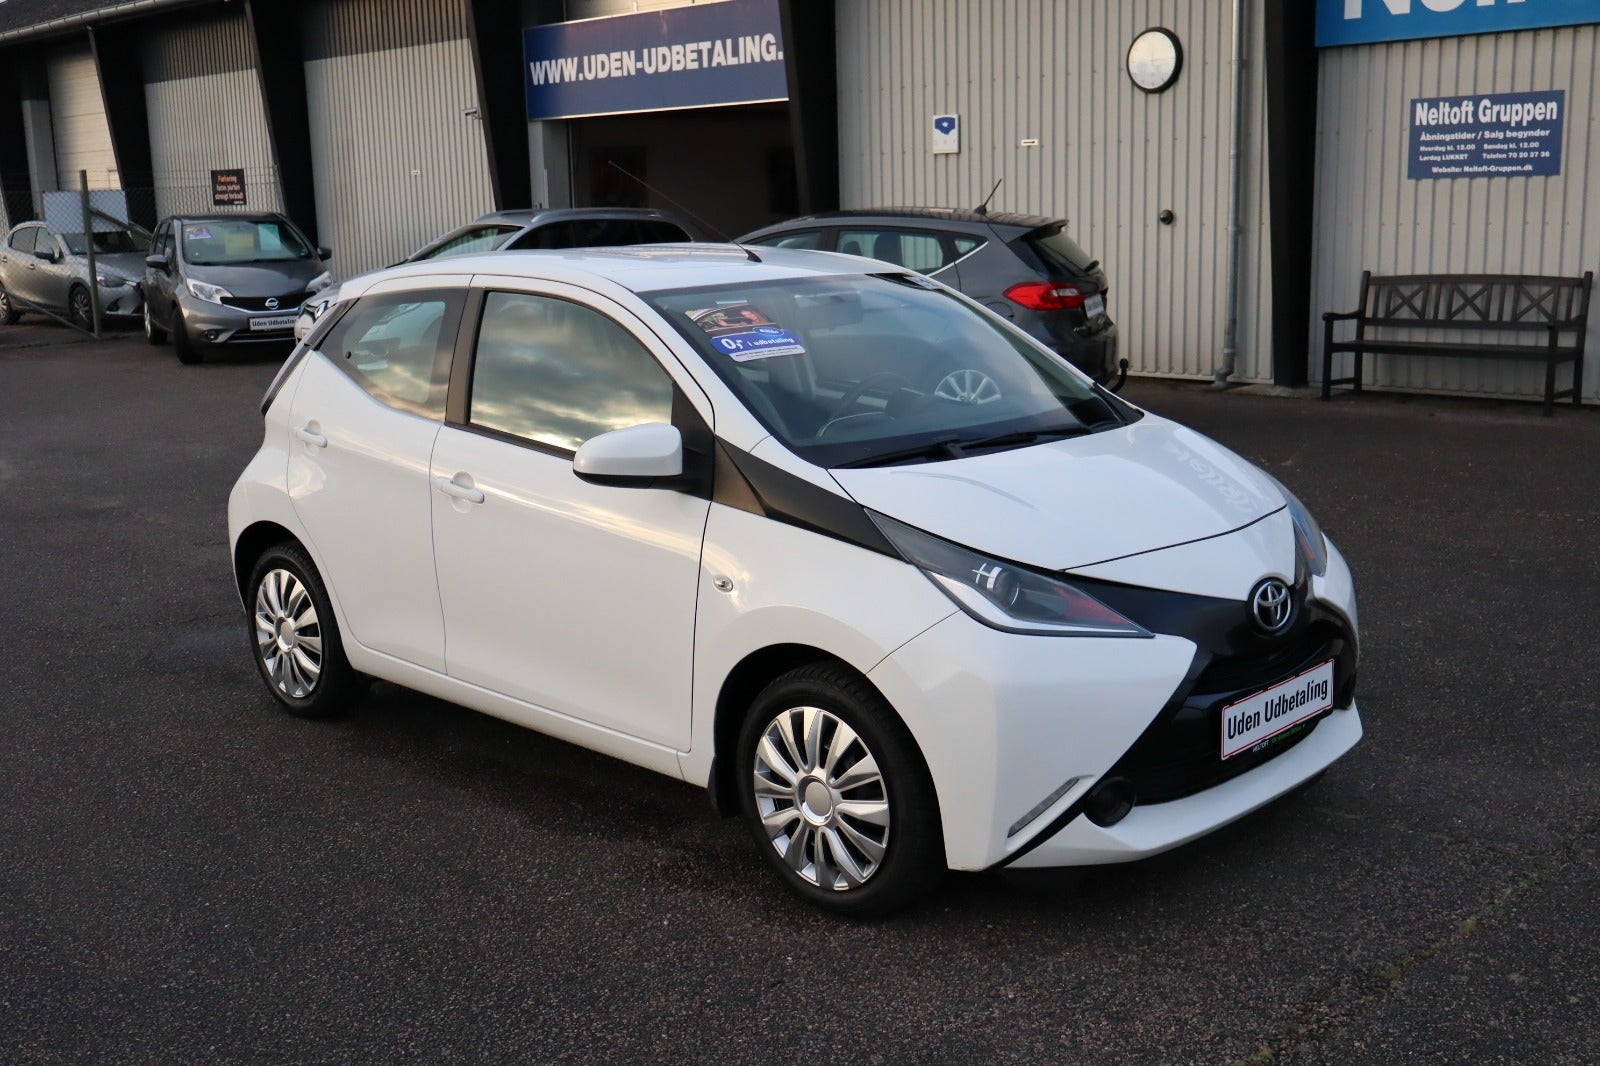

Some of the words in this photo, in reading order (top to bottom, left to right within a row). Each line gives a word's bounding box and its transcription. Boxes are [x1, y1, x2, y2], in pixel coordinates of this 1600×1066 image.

[1415, 100, 1474, 126] Neltoft
[1478, 99, 1558, 126] Gruppen
[1420, 131, 1476, 141] Åbningstider
[1484, 130, 1504, 139] Salg
[1506, 128, 1550, 139] begynder
[753, 337, 795, 346] udbetaling
[1227, 710, 1260, 740] Uden
[1264, 679, 1328, 723] Udbetaling
